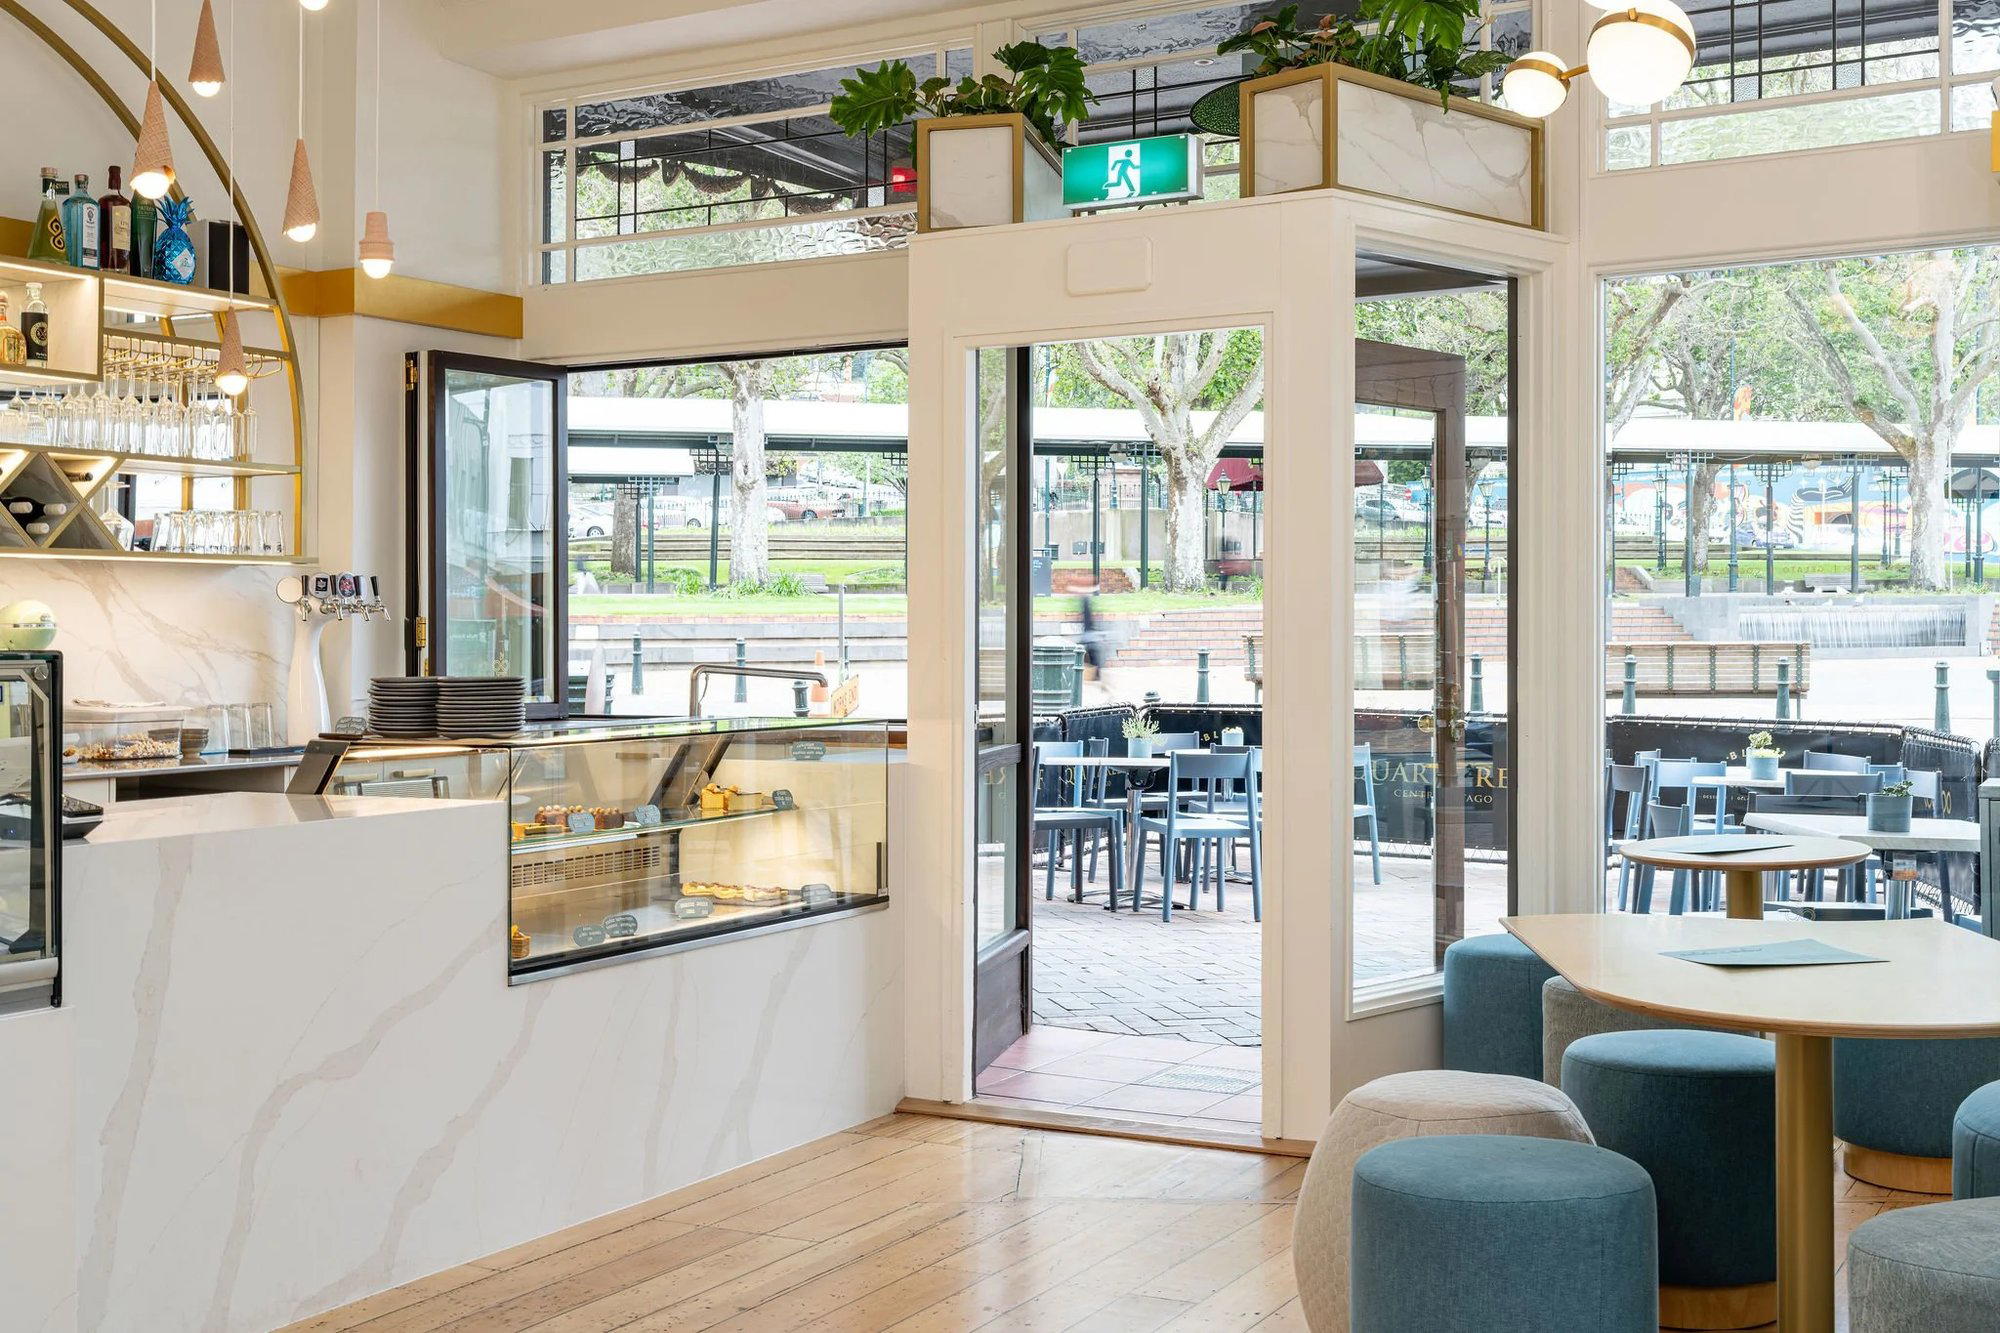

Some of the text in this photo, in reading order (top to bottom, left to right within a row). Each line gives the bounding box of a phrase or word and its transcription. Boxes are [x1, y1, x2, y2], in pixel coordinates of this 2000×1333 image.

[1476, 767, 1508, 789] RE
[1393, 789, 1493, 804] CENTR AGO
